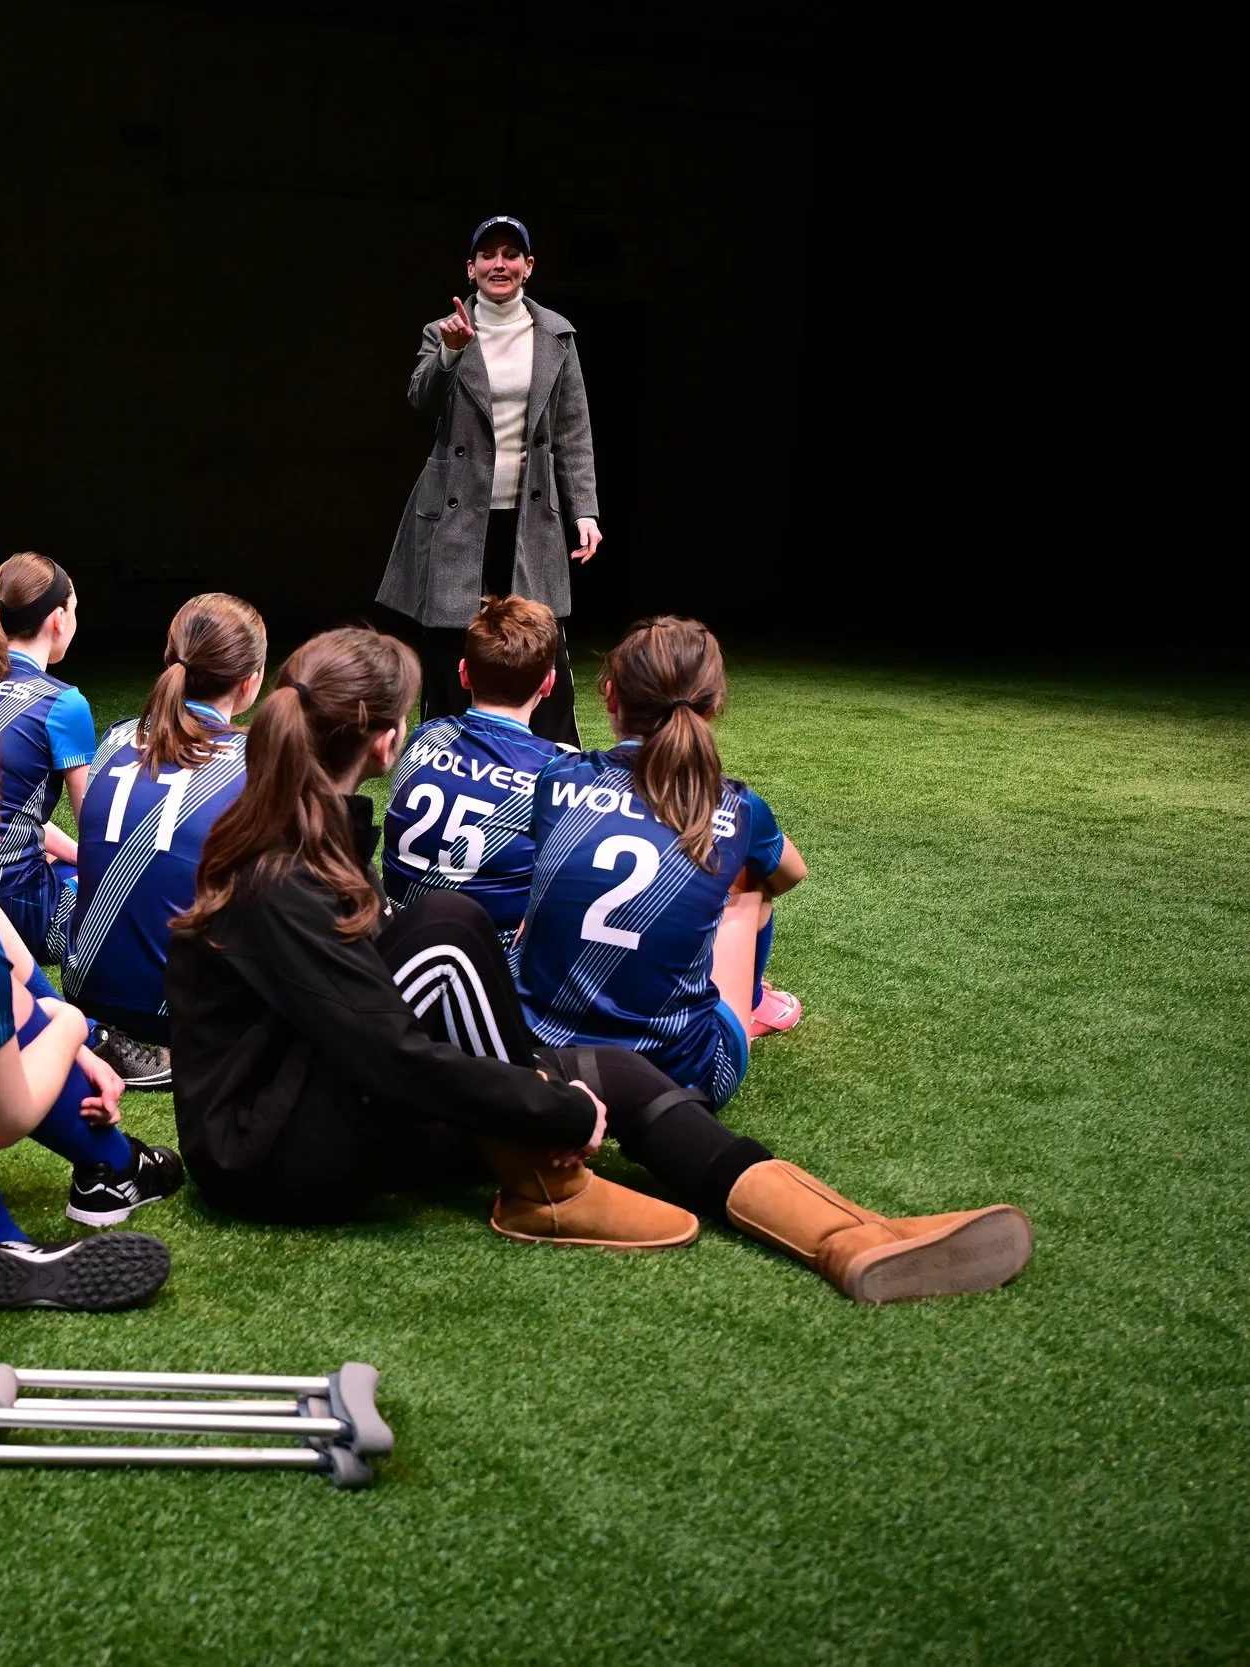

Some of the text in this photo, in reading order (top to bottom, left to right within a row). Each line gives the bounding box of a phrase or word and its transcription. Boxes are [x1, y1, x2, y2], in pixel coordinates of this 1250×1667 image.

[104, 761, 194, 852] 11
[410, 740, 537, 795] WOLVES
[551, 781, 737, 838] WOLS
[397, 783, 496, 882] 25
[580, 834, 660, 951] 2
